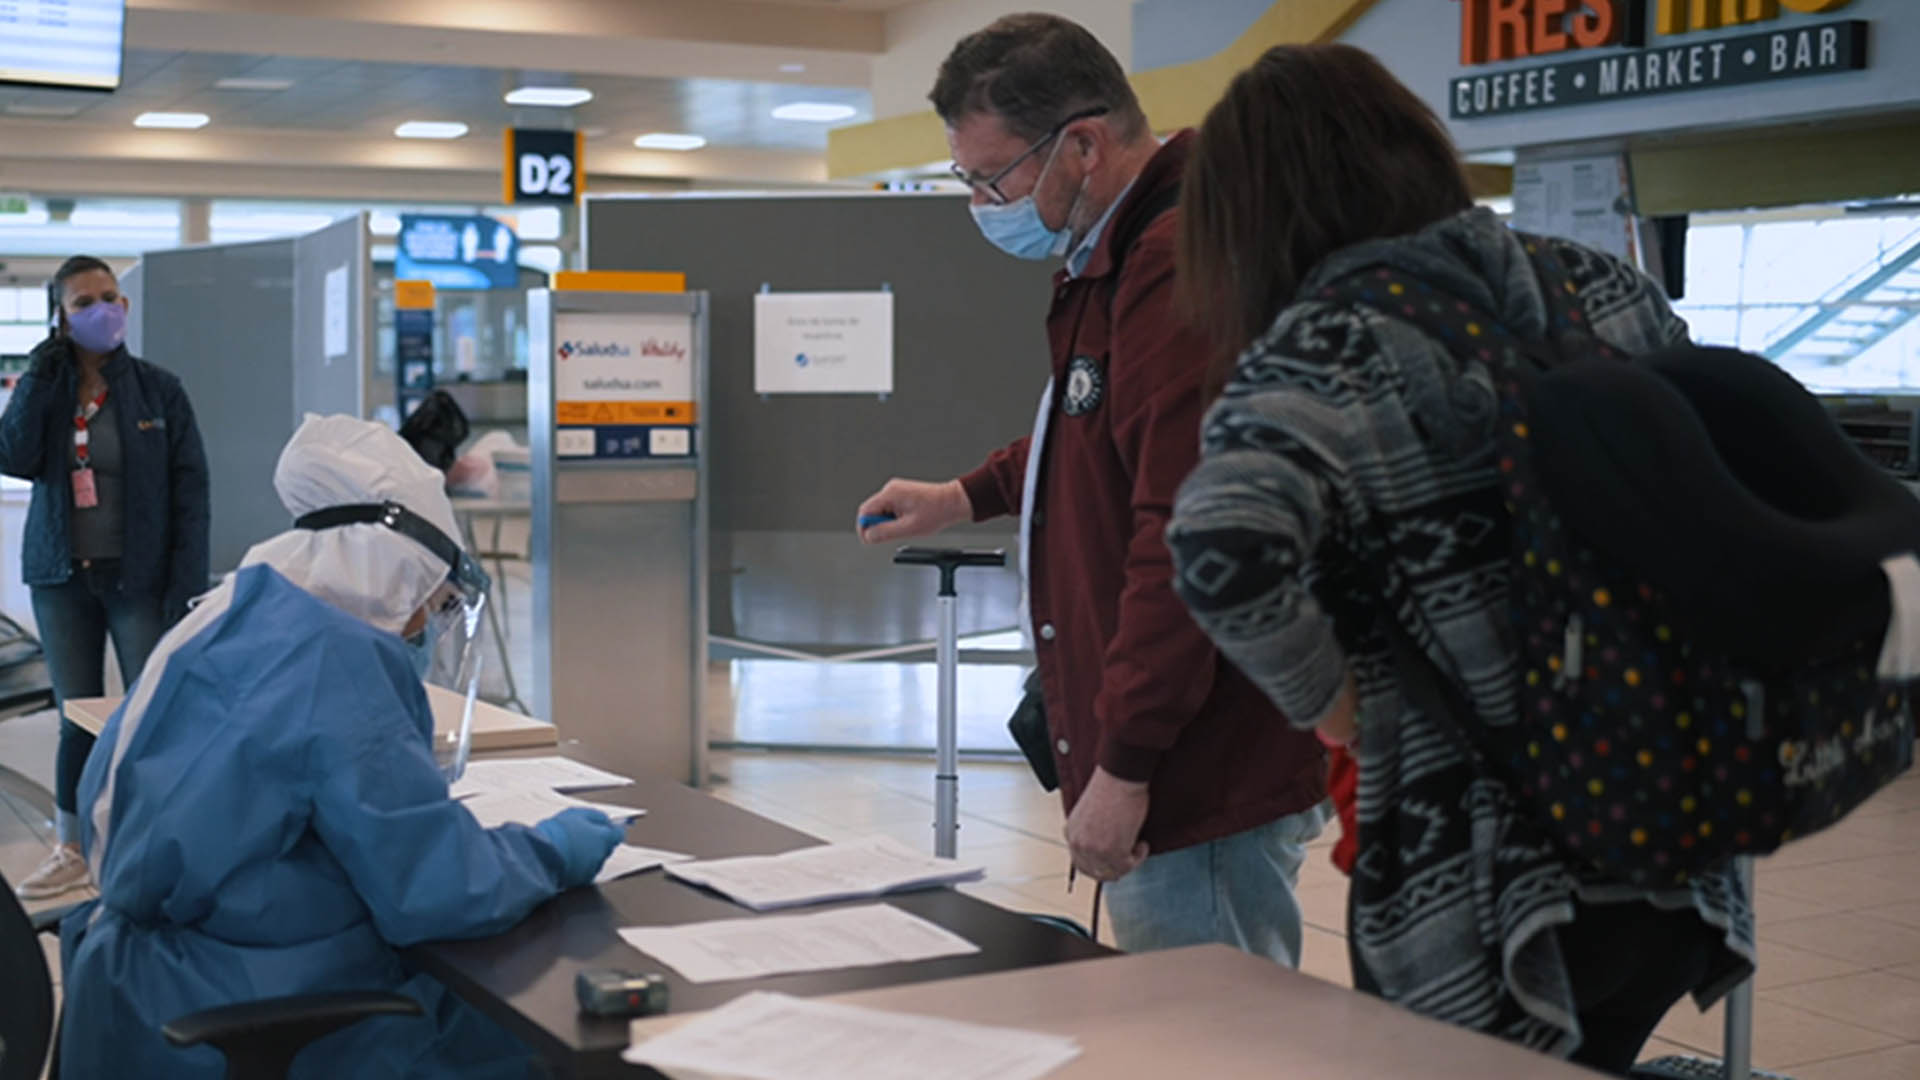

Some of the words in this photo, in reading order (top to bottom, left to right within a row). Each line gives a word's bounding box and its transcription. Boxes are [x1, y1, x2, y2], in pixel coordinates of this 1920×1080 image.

[1456, 67, 1559, 114] COFFEE
[1597, 42, 1725, 95] MARKET
[1770, 27, 1837, 73] BAR
[520, 153, 572, 194] D2
